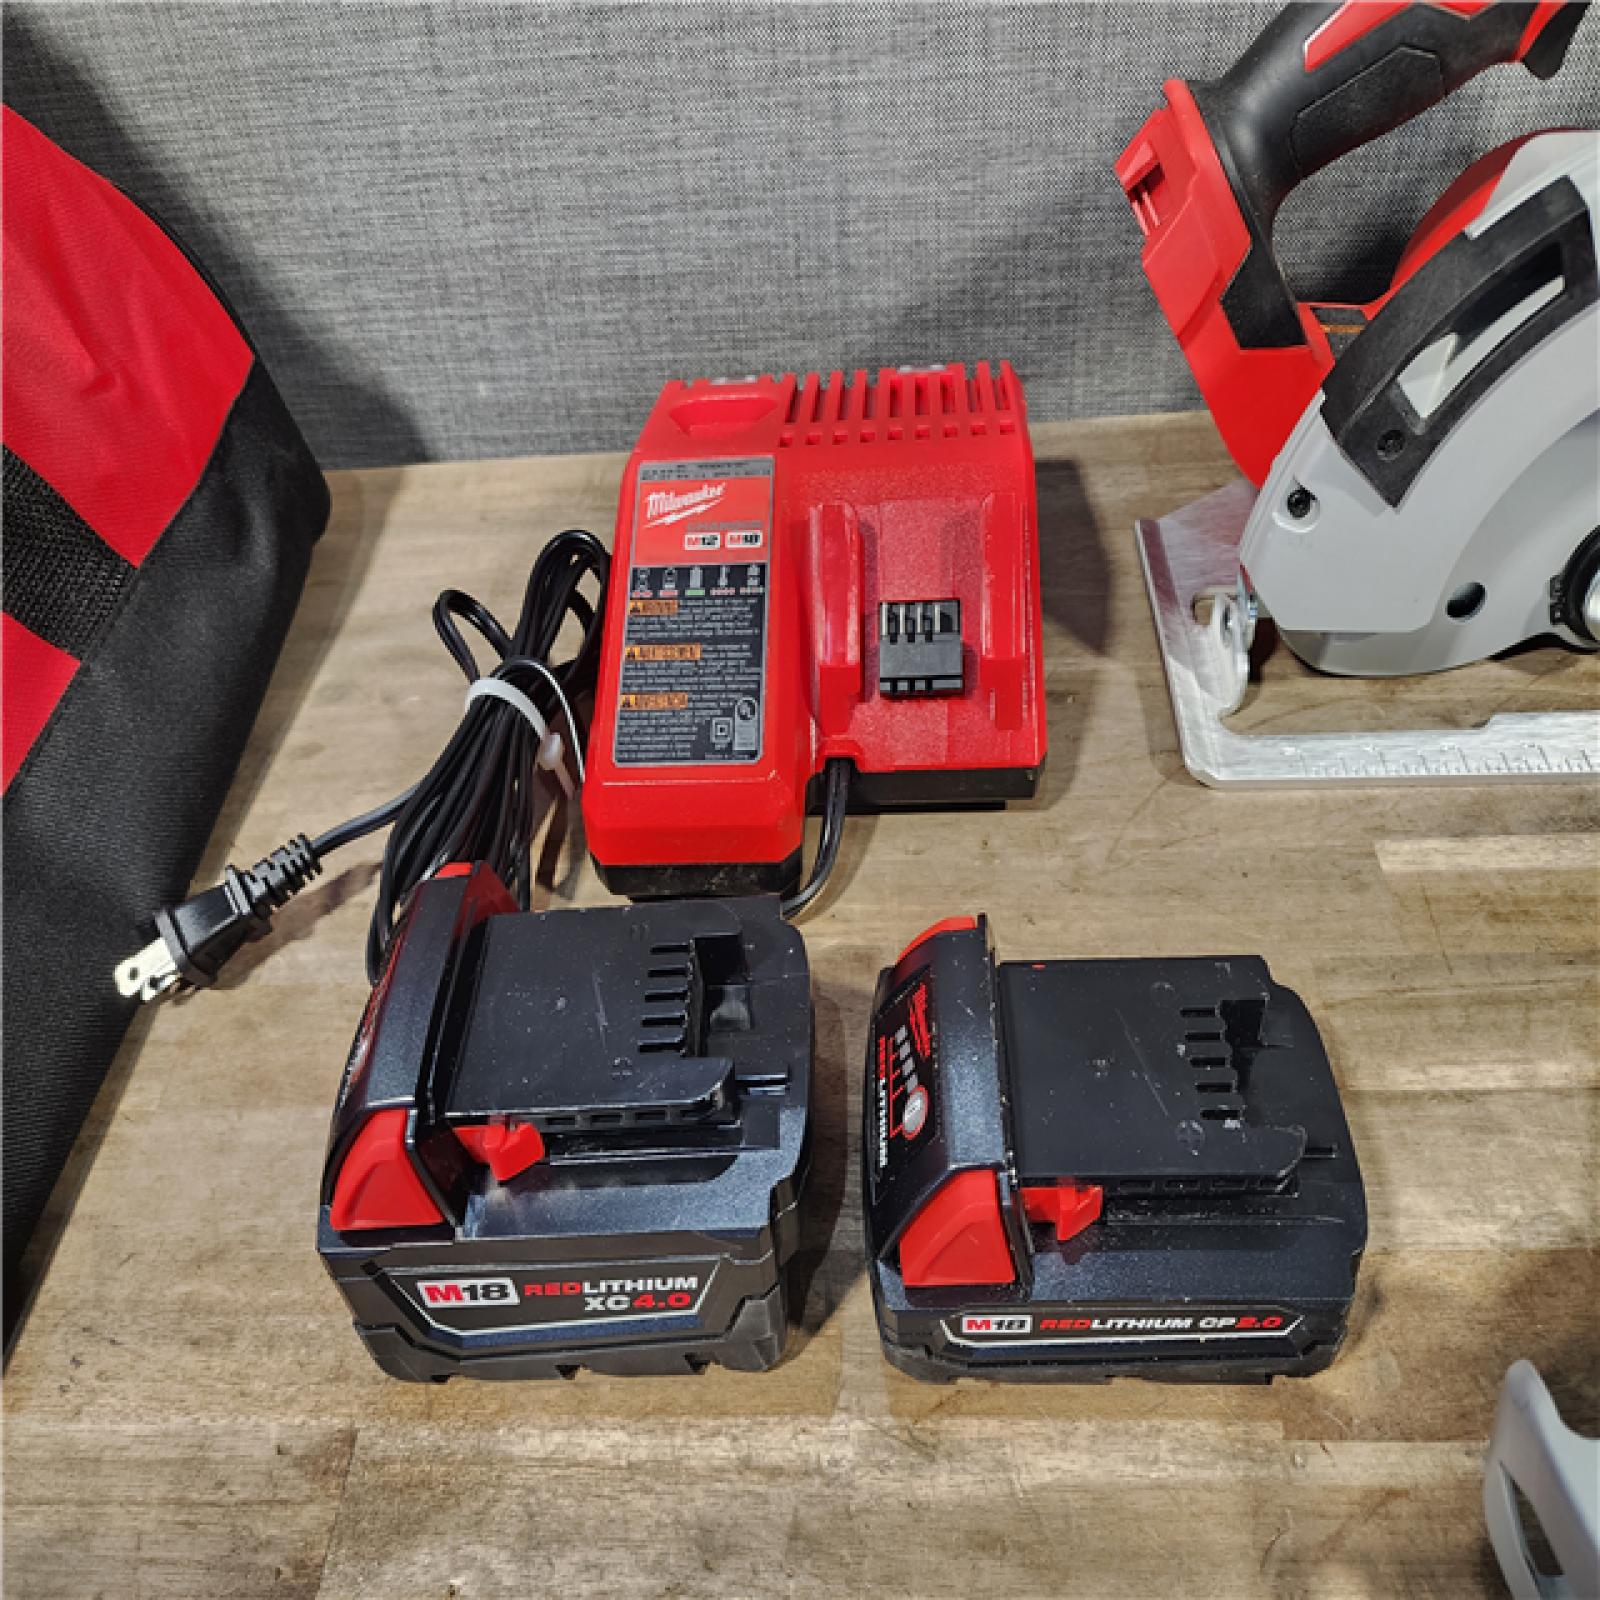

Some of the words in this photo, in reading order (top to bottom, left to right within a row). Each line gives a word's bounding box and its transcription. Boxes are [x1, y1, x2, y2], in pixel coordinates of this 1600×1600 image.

[425, 1284, 508, 1302] M18
[524, 1277, 698, 1296] REDLITHIUM
[585, 1291, 690, 1311] XC4.0
[966, 1318, 1030, 1331] M18
[1040, 1316, 1193, 1330] REDLITHIUM
